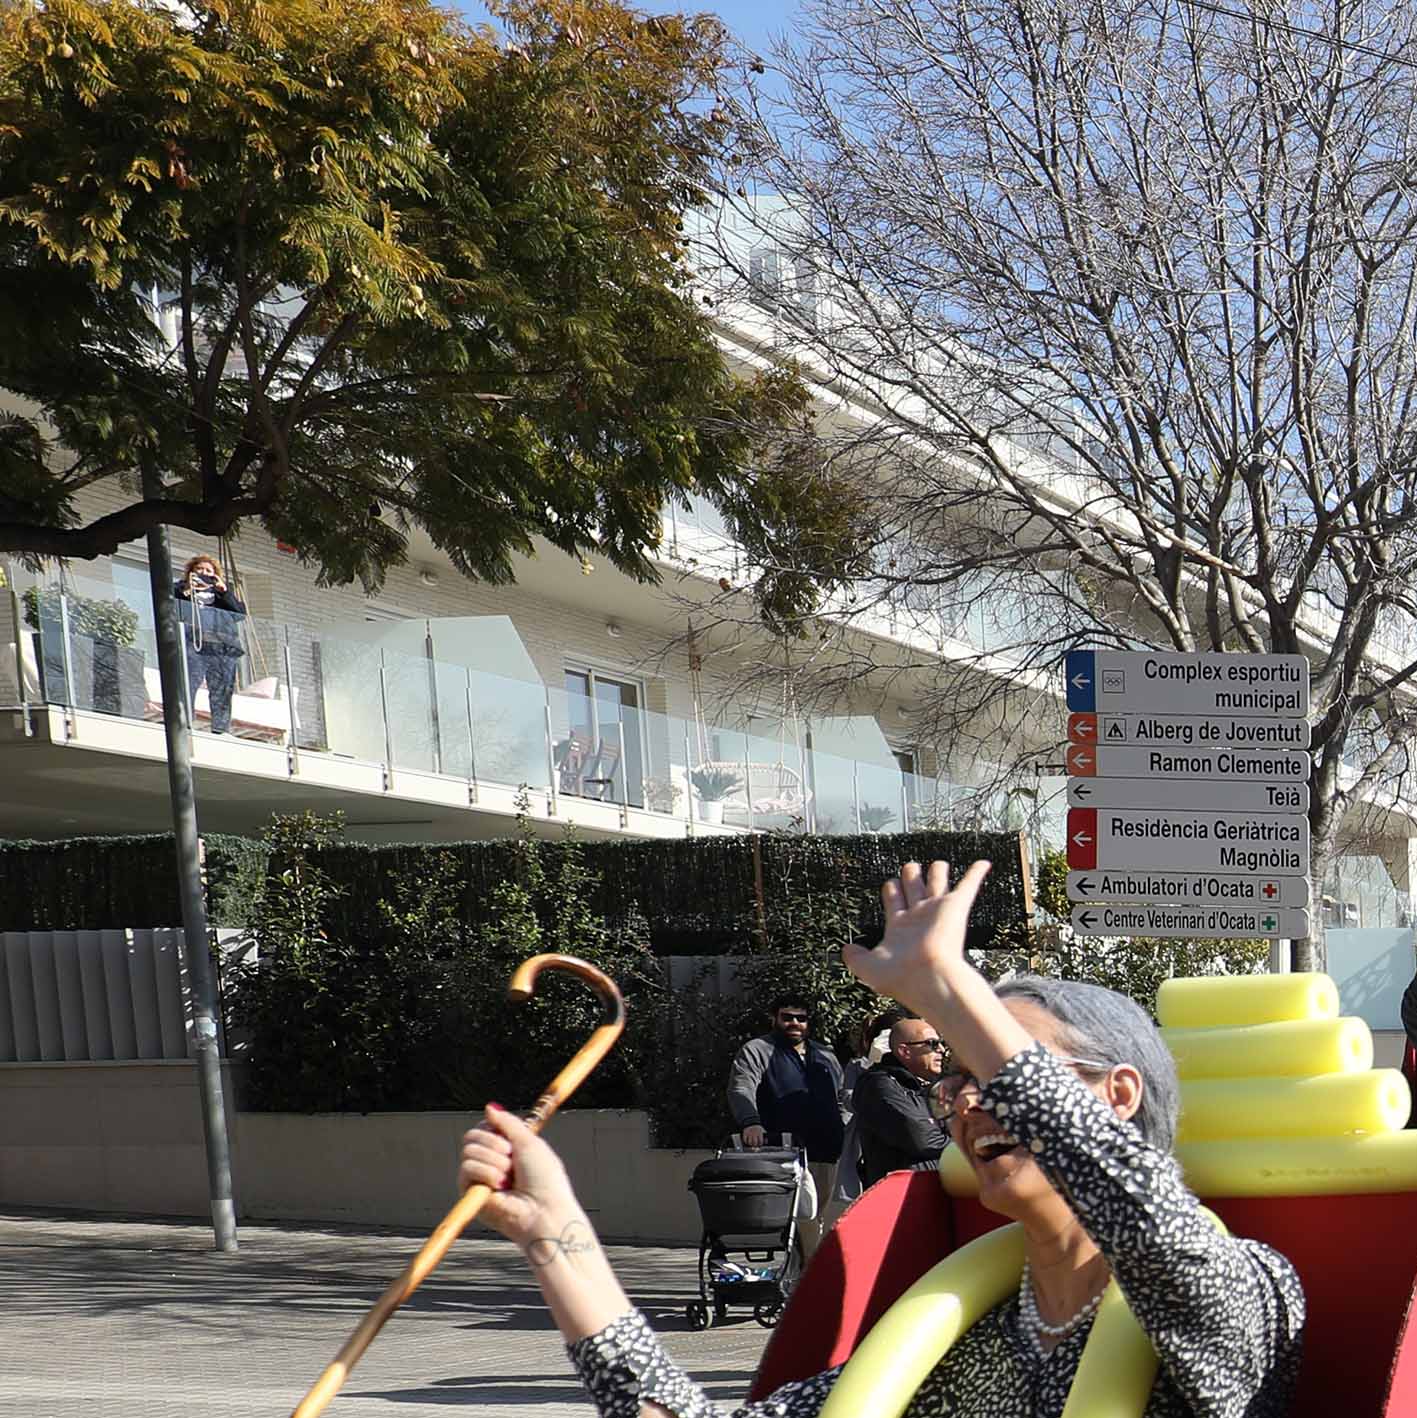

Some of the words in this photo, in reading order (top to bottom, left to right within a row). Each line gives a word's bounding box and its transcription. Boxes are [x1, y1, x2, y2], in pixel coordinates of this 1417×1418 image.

[1145, 660, 1222, 683] Complex
[1228, 662, 1301, 684] esportiu
[1215, 690, 1301, 712] municipal
[1136, 721, 1193, 743] Alberg
[1199, 722, 1219, 740] de
[1226, 724, 1302, 742] Joventut
[1150, 752, 1212, 773] Ramon
[1218, 755, 1302, 775] Clemente
[1266, 787, 1301, 806] Teià
[1111, 818, 1208, 839] Residència
[1214, 821, 1300, 841] Geriàtrica
[1220, 848, 1301, 871] Magnòlia
[1101, 877, 1188, 897] Ambulatori
[1193, 878, 1255, 898] d'Ocata
[1104, 910, 1144, 928] Centre
[1146, 911, 1205, 929] Veterinari
[1208, 912, 1256, 931] d'Ocata
